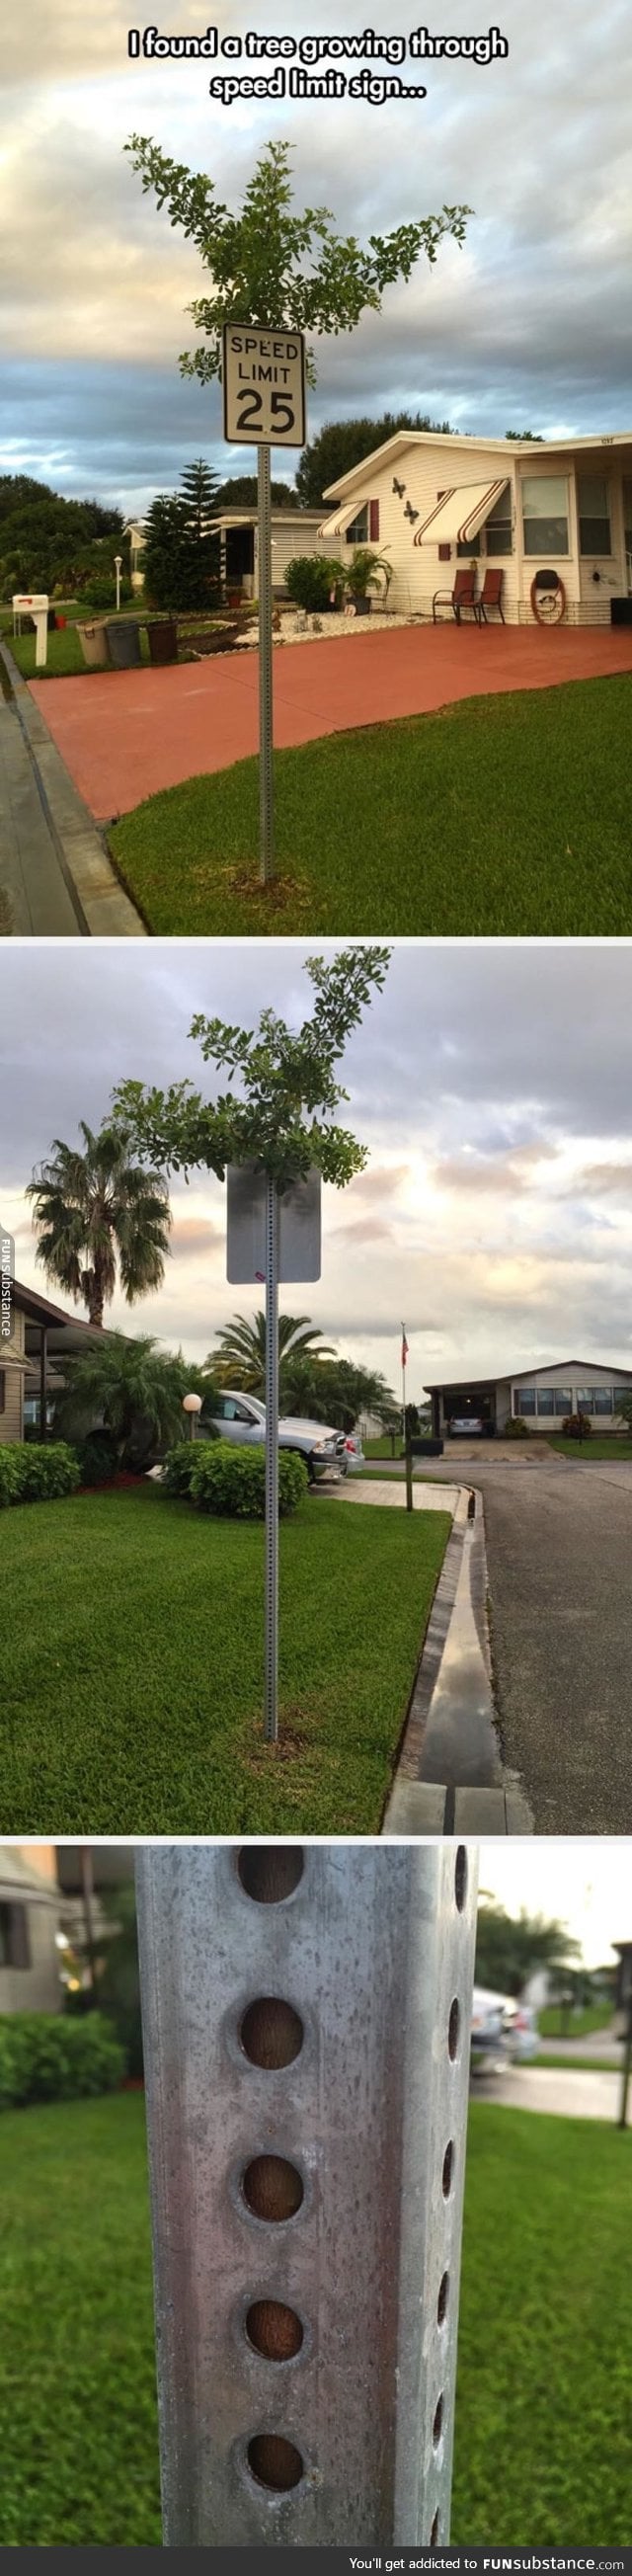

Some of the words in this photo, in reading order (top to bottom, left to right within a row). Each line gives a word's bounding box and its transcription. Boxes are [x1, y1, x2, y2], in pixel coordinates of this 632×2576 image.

[231, 337, 297, 360] SPEED
[238, 362, 290, 383] LIMIT
[236, 388, 294, 434] 25
